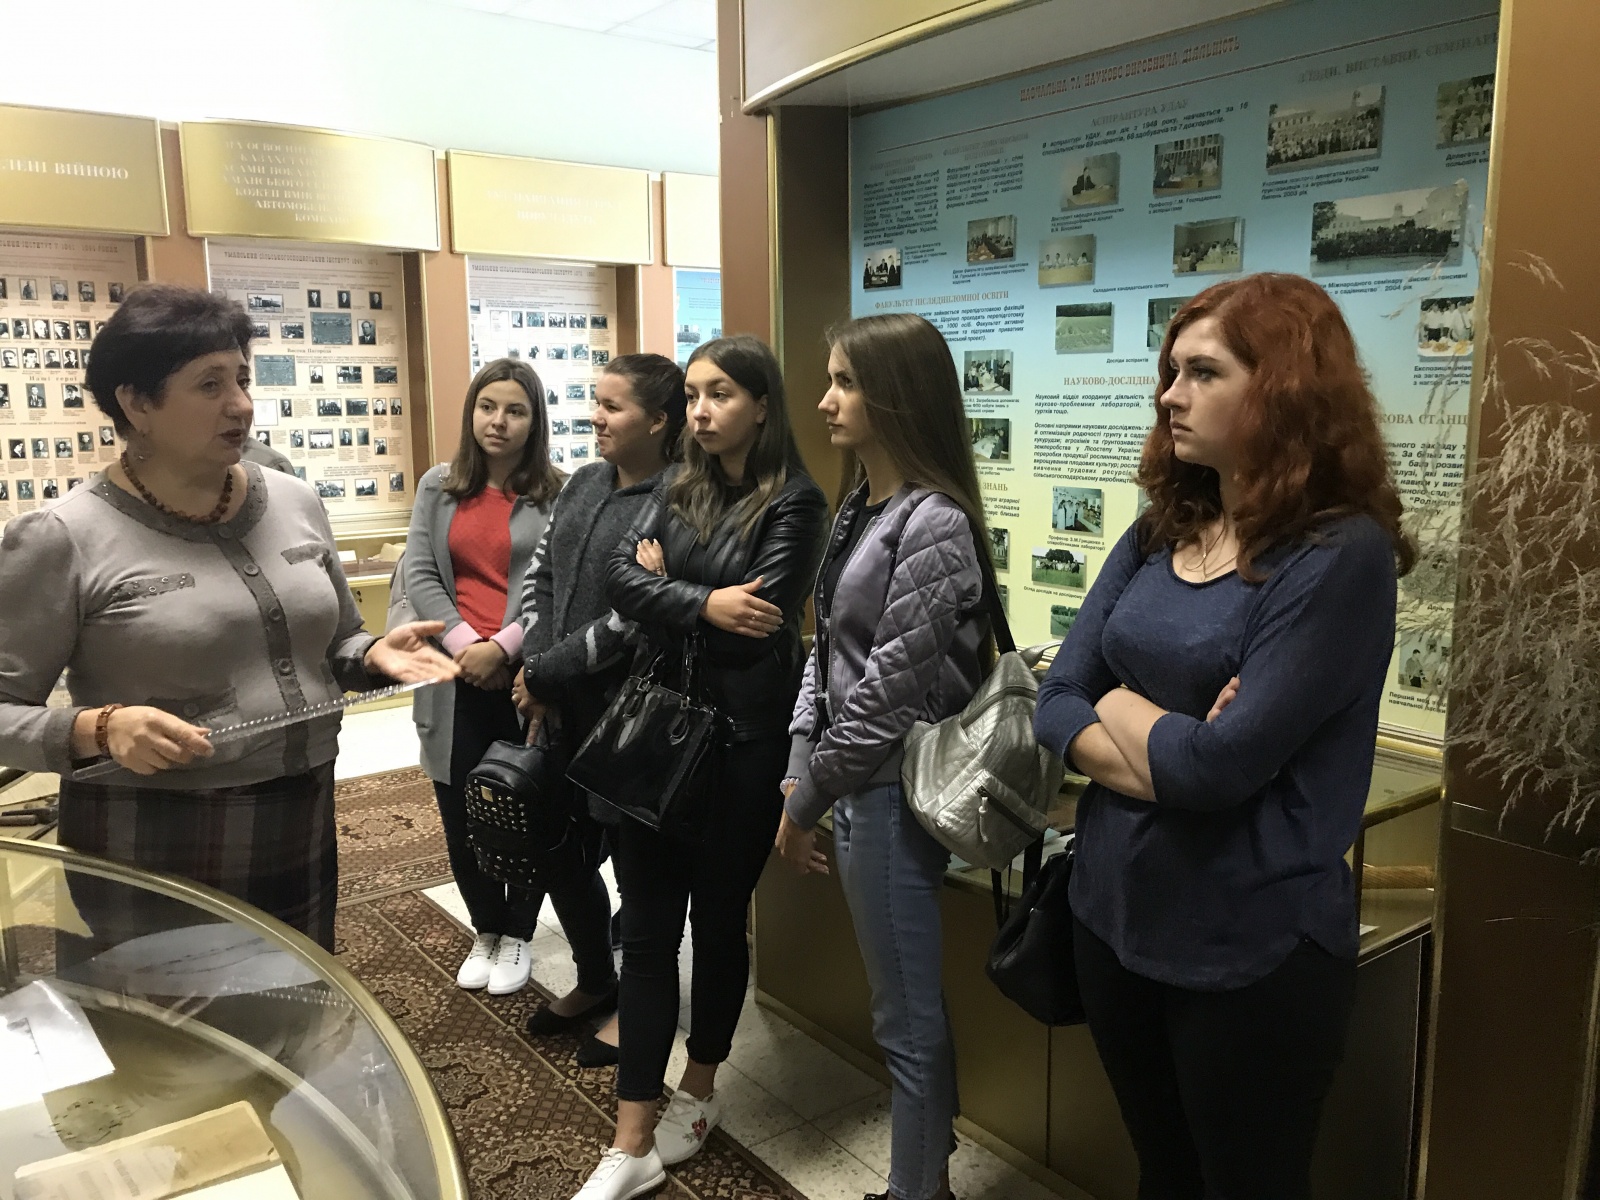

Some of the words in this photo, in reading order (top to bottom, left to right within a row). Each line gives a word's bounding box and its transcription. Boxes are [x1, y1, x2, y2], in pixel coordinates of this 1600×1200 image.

[1182, 108, 1222, 121] навчається
[54, 161, 129, 180] ВІЙНОЮ
[1328, 280, 1372, 289] Міжнародного
[1373, 278, 1403, 287] семінару
[1402, 284, 1413, 292] рік
[874, 299, 914, 310] ФАКУЛЬТЕТ
[981, 290, 1009, 301] ОСВІТИ
[961, 306, 1002, 315] перепідготовкою
[1003, 303, 1025, 312] фахівців
[987, 311, 1025, 321] перепідготовку
[1063, 375, 1156, 387] НАУКОВО-ДОСЛІДНА
[1034, 393, 1060, 401] Науковий
[1081, 393, 1112, 401] координує
[1034, 400, 1096, 408] науково-проблемних
[1100, 401, 1142, 409] лабораторій,
[1055, 423, 1082, 431] напрямки
[1108, 424, 1144, 432] досліджень:
[1033, 444, 1071, 452] землеробства
[1084, 445, 1113, 454] Лісостепу
[1401, 450, 1413, 458] За
[1033, 451, 1062, 459] переробки
[1062, 452, 1090, 460] продукції
[1089, 453, 1132, 462] рослинництва;
[1033, 458, 1069, 466] вирощування
[1095, 460, 1120, 469] культур;
[1408, 459, 1429, 468] база
[1067, 467, 1097, 475] трудових
[1033, 472, 1099, 482] сільськогосподарському
[982, 482, 1009, 492] ЗНАНЬ
[998, 496, 1021, 505] аграрної
[993, 503, 1020, 511] оснащена
[999, 509, 1020, 518] близько
[1080, 543, 1106, 551] лабораторії
[1388, 691, 1415, 702] Перший
[1388, 698, 1424, 710] навчальної
